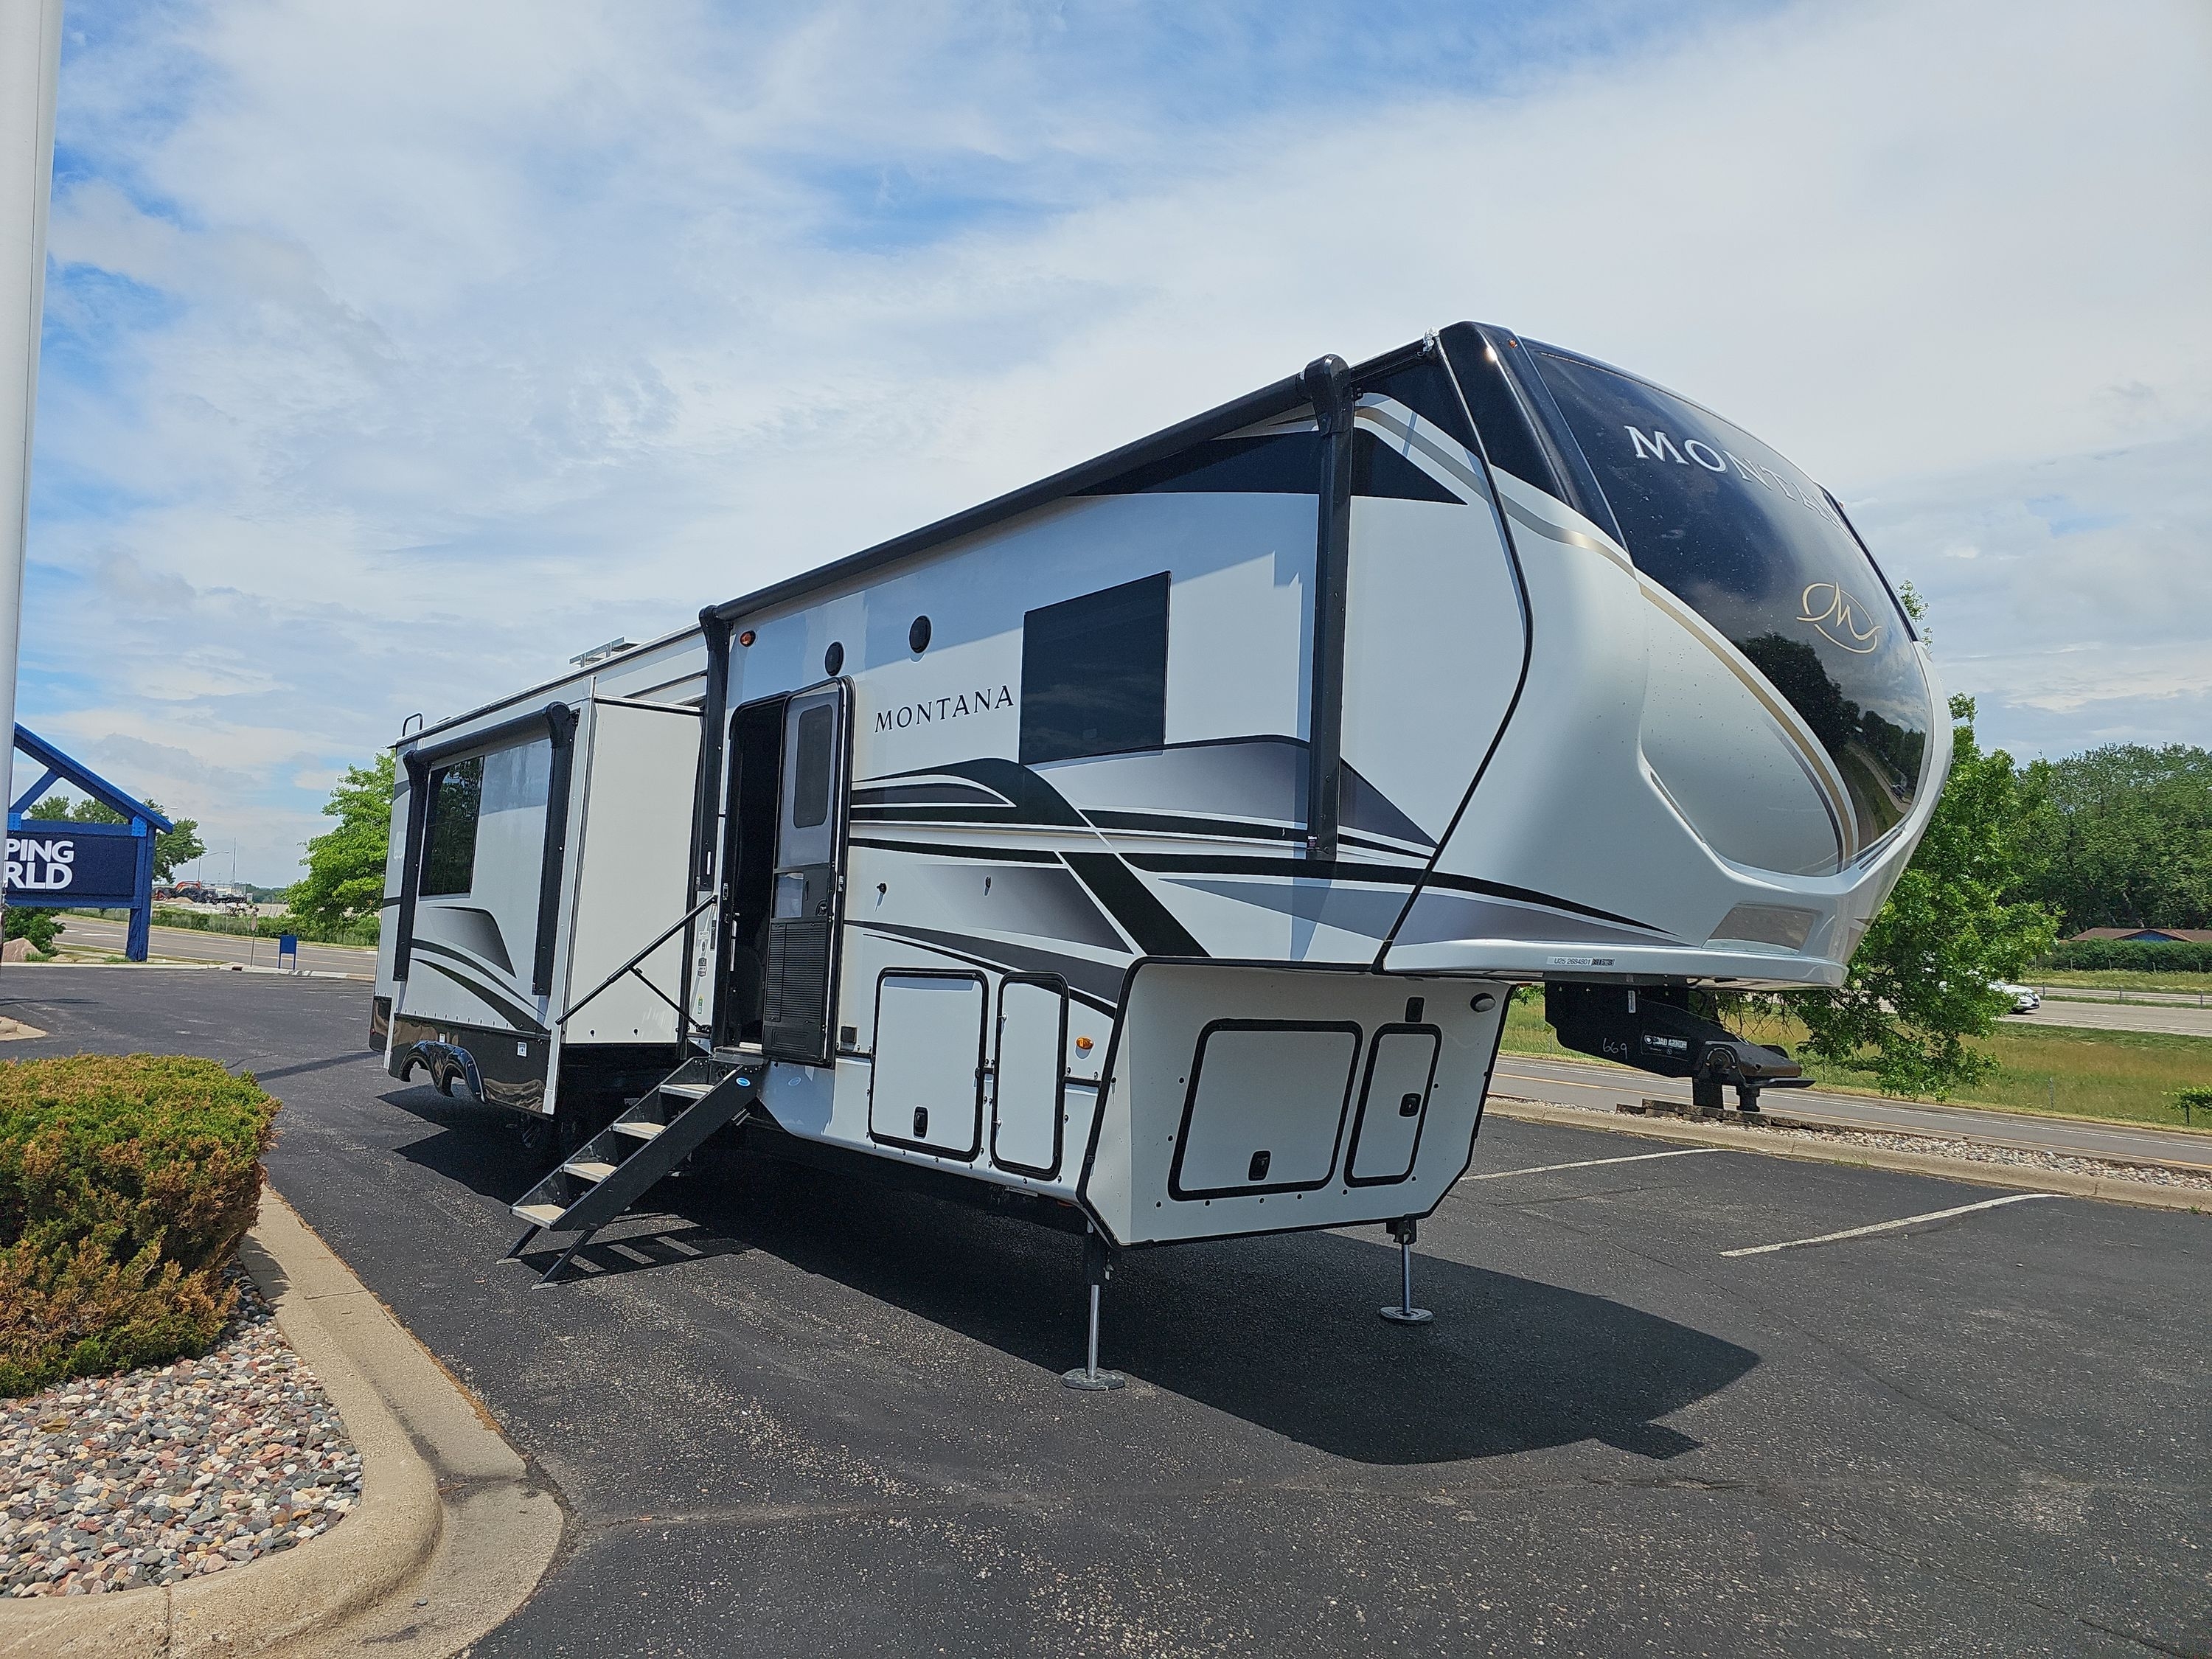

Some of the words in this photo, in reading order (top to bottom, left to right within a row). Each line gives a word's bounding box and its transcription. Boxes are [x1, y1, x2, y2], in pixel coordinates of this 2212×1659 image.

[1624, 425, 1860, 548] MONTAN
[874, 684, 1015, 733] MONTANA
[4, 838, 74, 863] PING
[3, 861, 73, 889] RLD
[1602, 1037, 1628, 1060] 669
